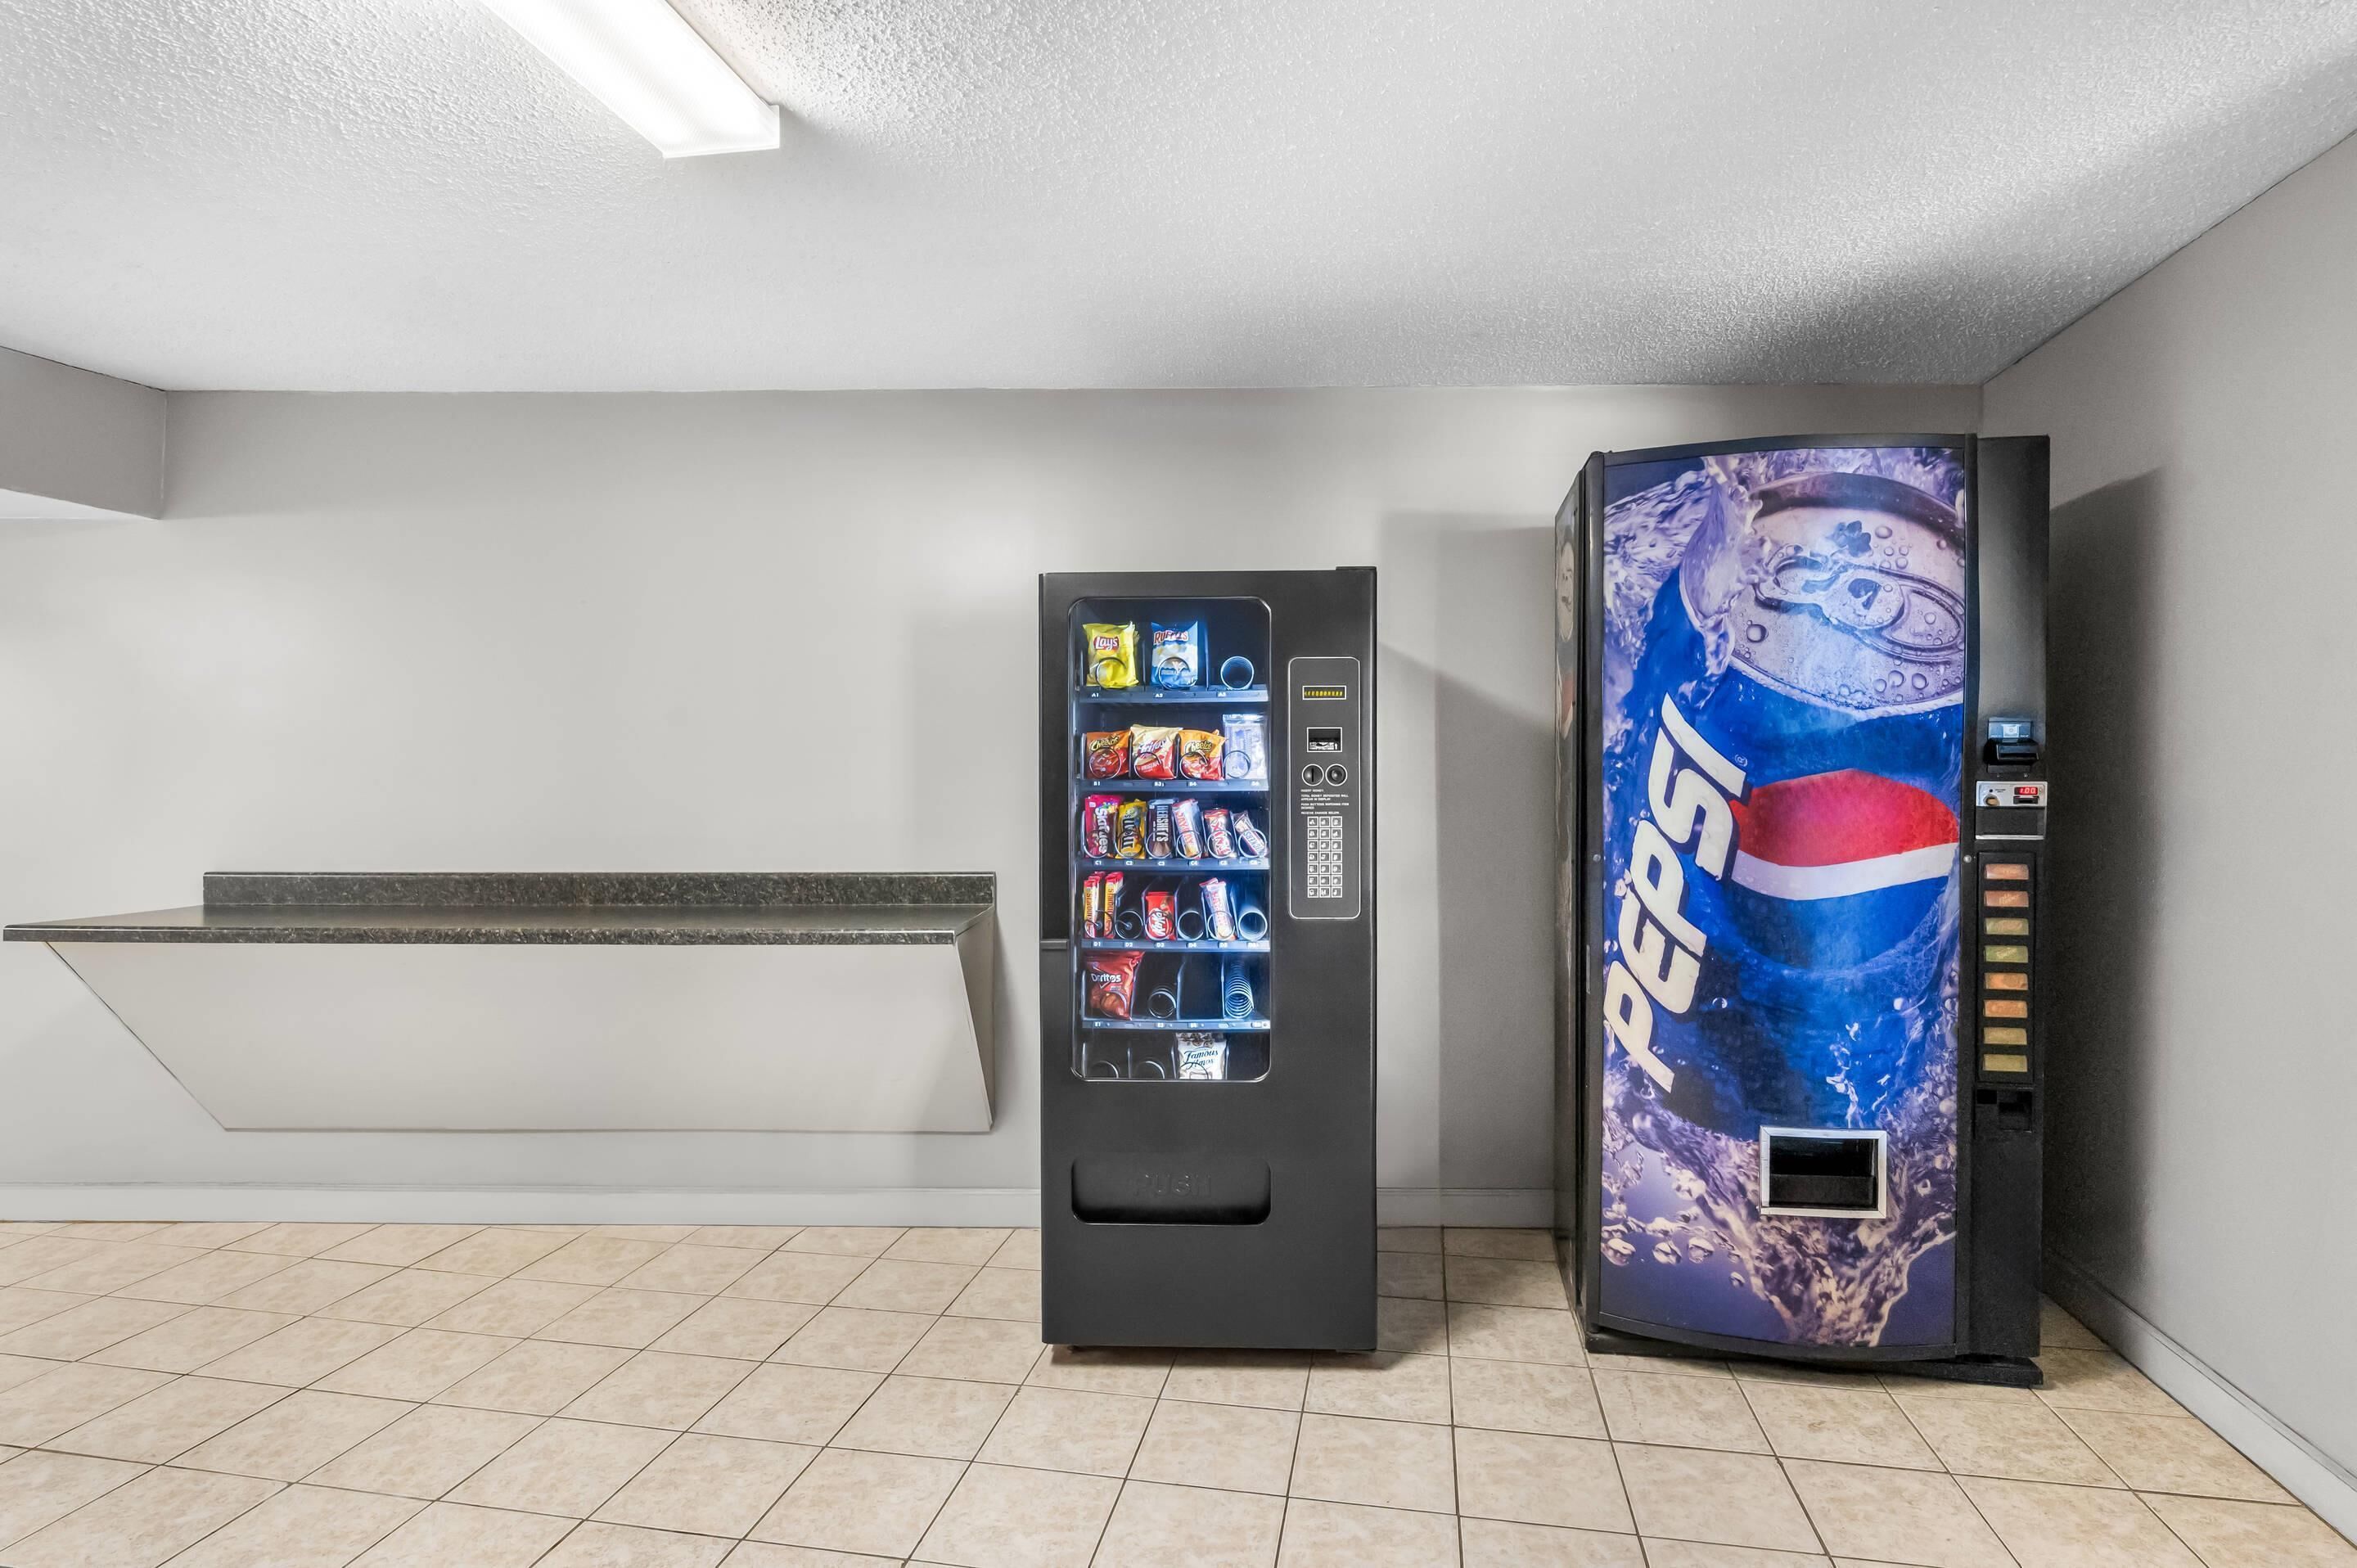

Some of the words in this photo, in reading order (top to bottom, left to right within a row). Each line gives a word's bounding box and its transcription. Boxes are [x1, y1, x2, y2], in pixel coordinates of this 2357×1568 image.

[1186, 739, 1213, 753] Cheetos
[1603, 692, 1746, 1093] PEPSI
[1091, 973, 1121, 982] Doritos
[1183, 1049, 1219, 1070] Famous
